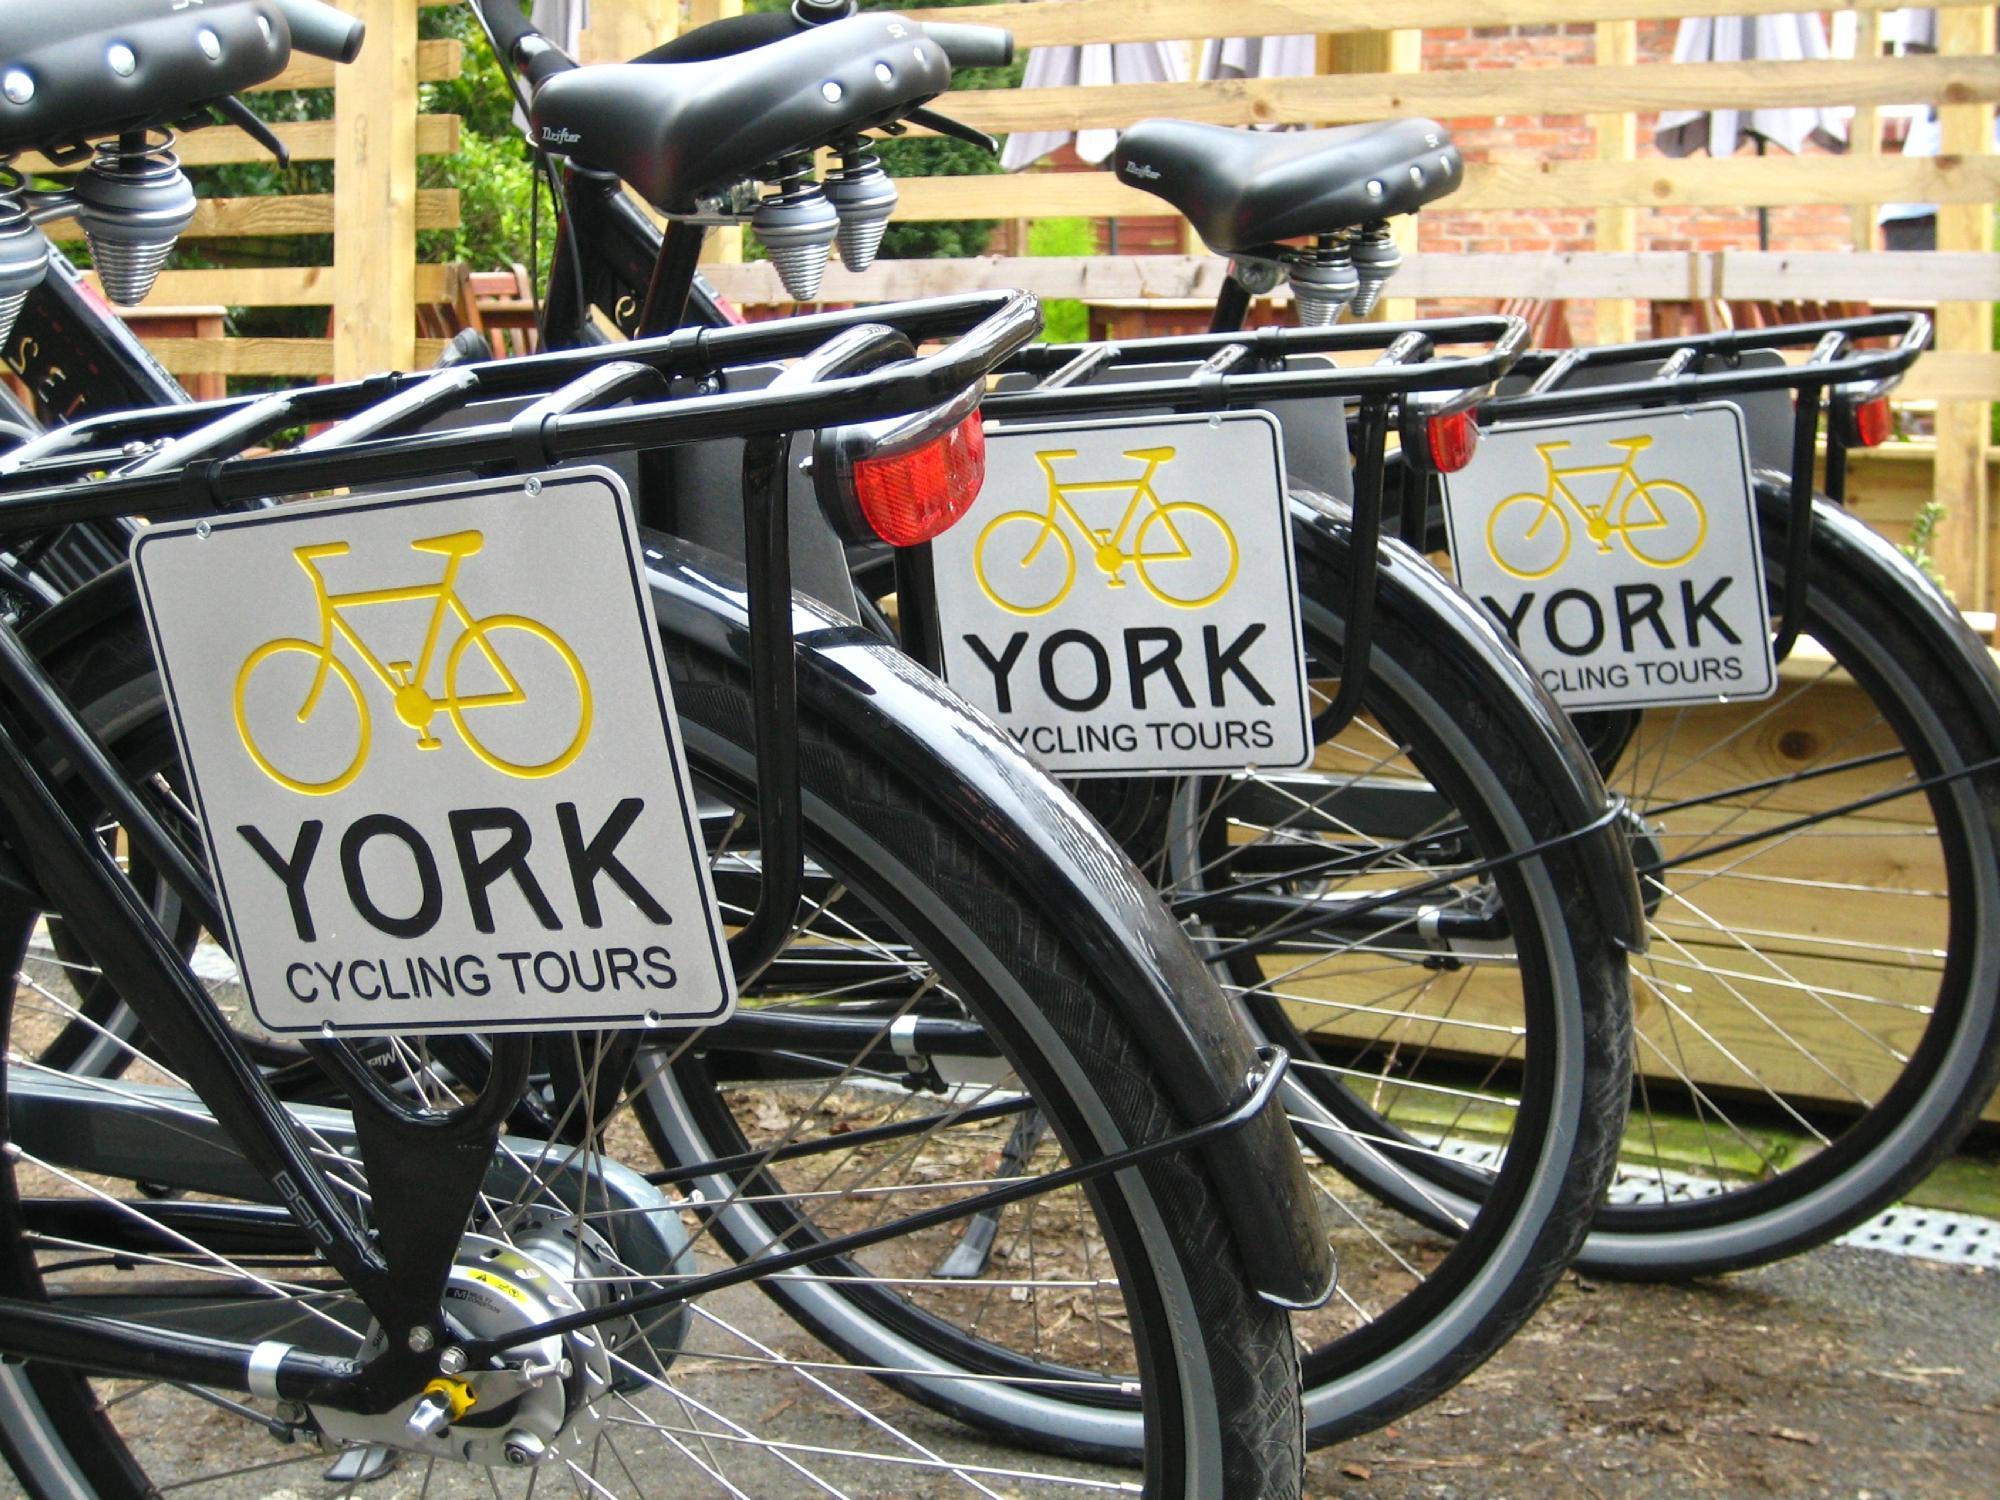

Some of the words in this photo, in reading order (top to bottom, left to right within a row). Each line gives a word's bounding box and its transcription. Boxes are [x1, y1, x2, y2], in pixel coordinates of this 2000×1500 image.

[1480, 576, 1742, 656] YORK
[963, 624, 1275, 713] YORK
[1541, 664, 1629, 692] CLING
[1637, 657, 1742, 684] TOURS
[1007, 723, 1137, 754] YCLING
[1146, 721, 1273, 750] TOURS
[237, 798, 672, 942] YORK
[286, 955, 490, 1003] CYCLING
[497, 946, 677, 994] TOURS
